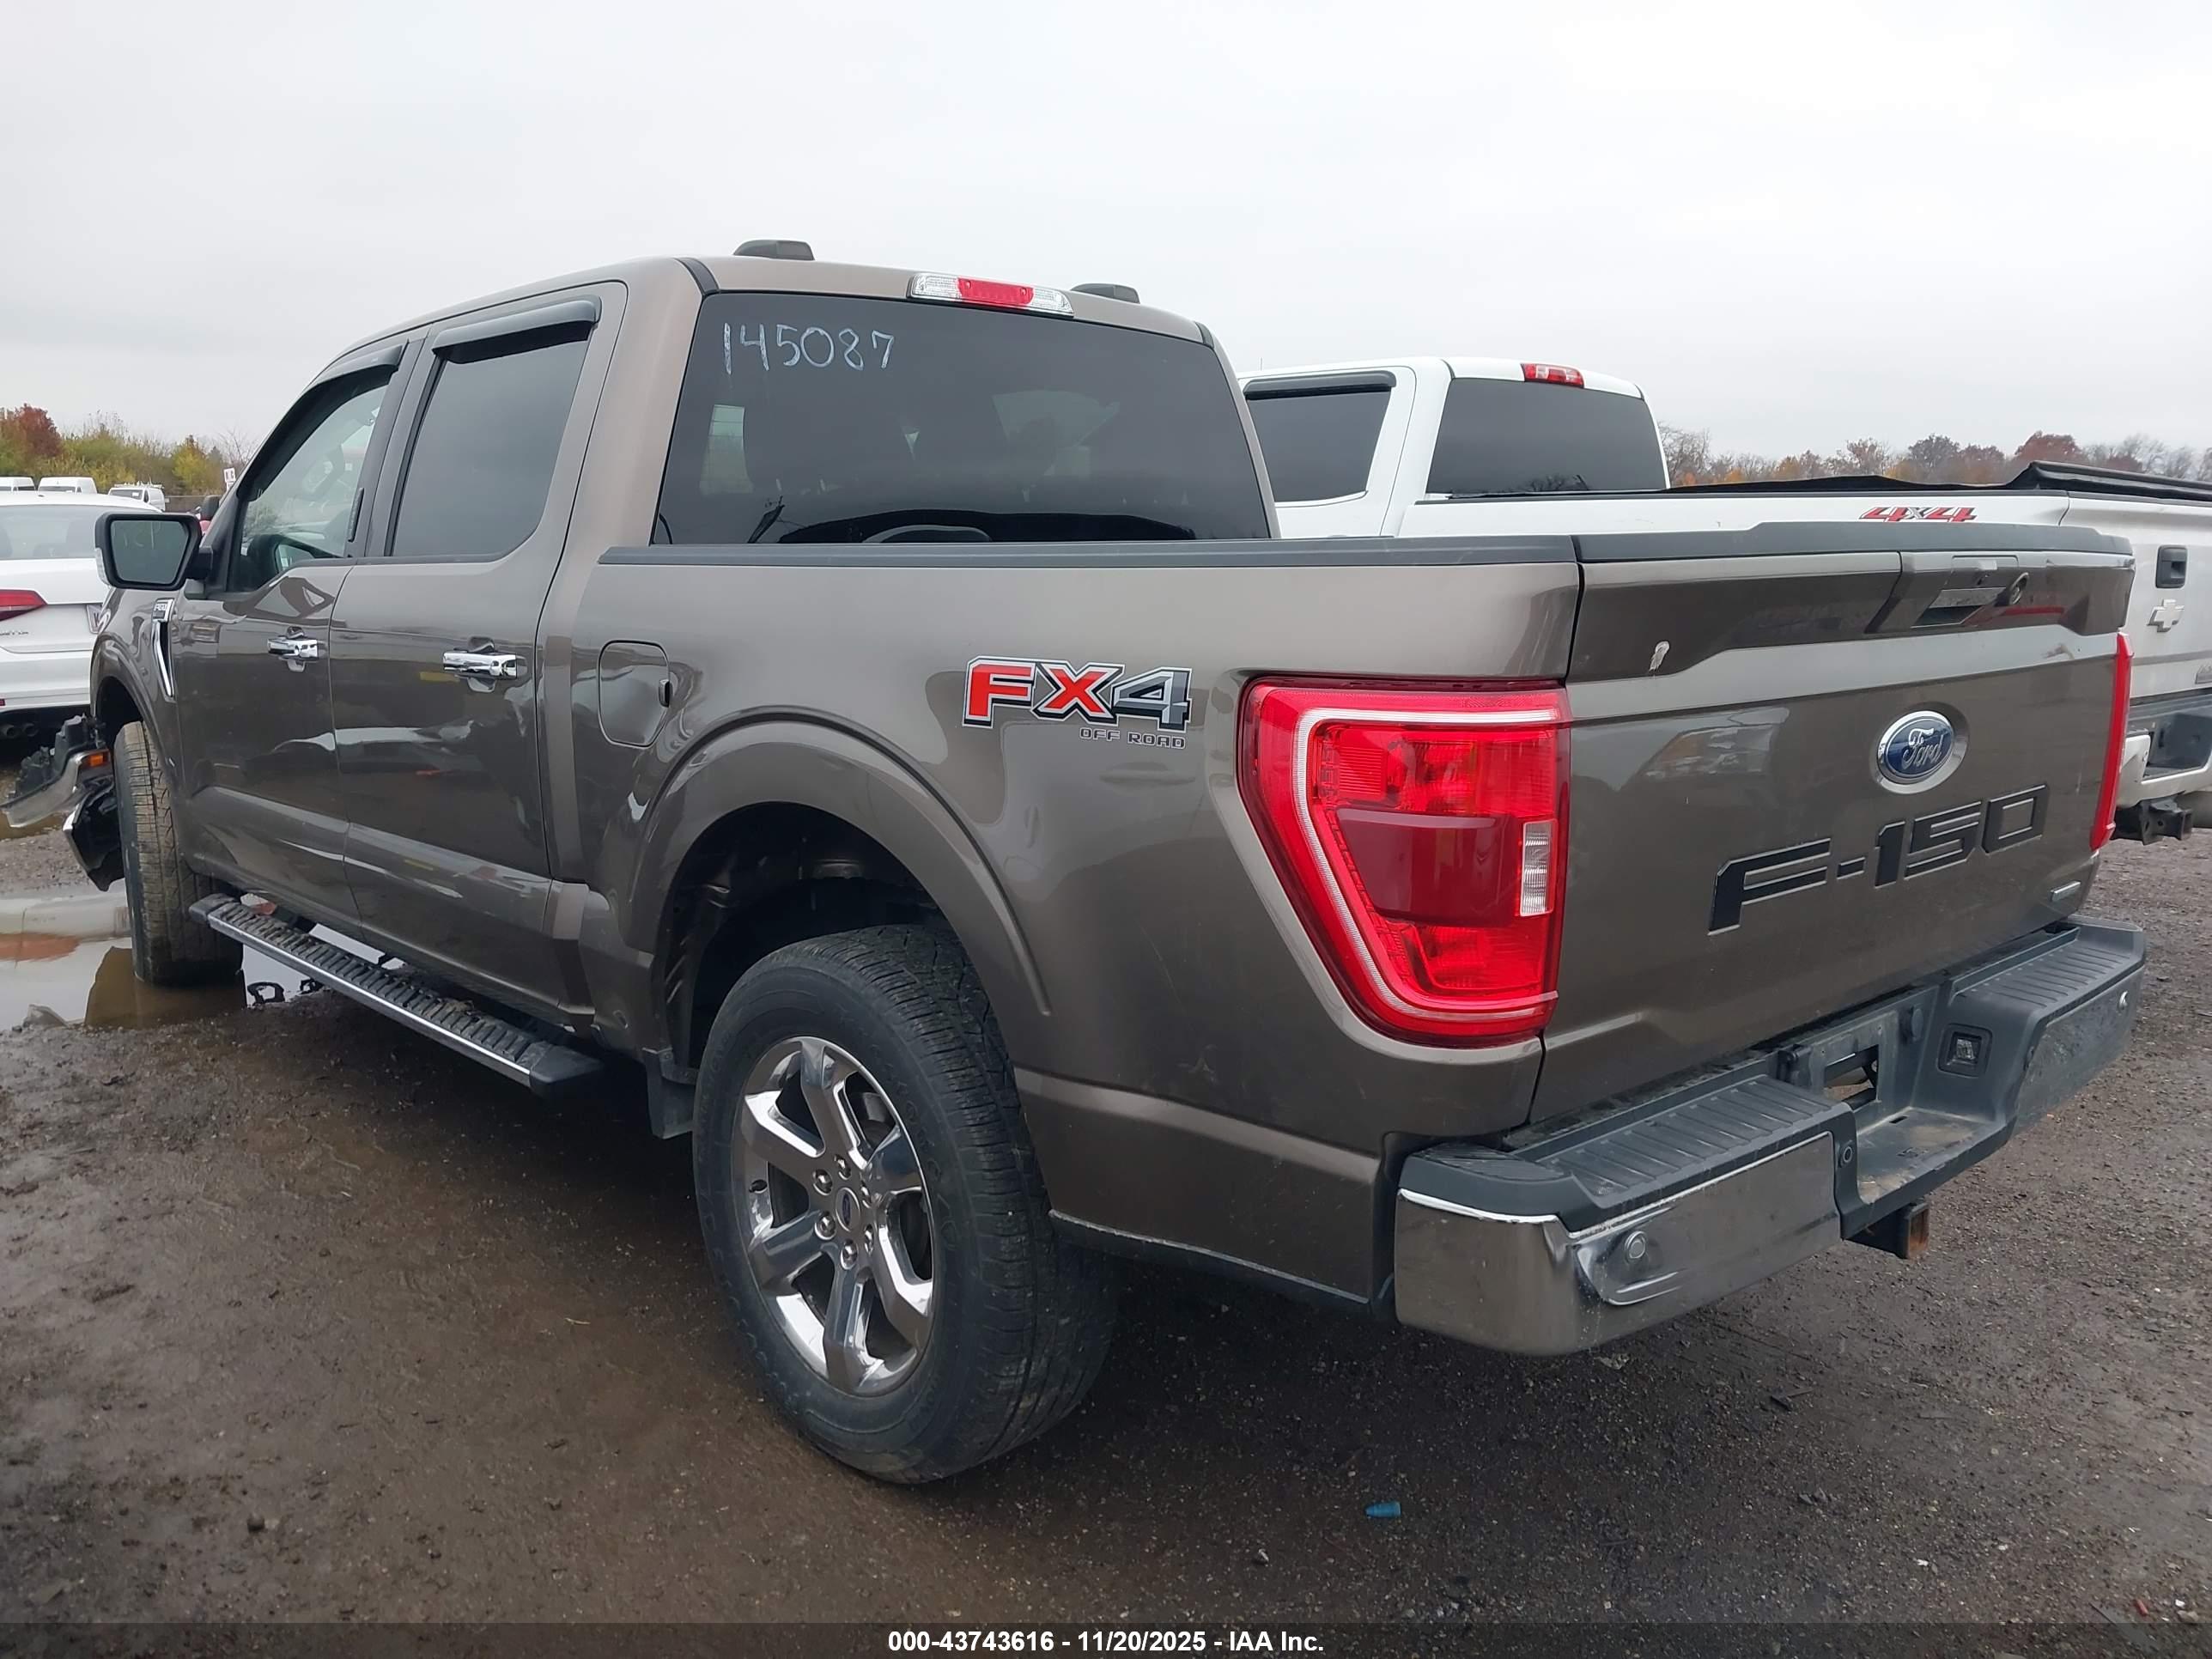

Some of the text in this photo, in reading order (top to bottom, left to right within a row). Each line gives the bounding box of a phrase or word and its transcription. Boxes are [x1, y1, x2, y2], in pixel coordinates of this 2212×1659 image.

[723, 322, 894, 374] 145087
[962, 655, 1193, 732] FX4
[1079, 727, 1186, 750] OFF ROAD
[1901, 727, 1945, 770] Ford
[1707, 784, 2050, 936] F-150
